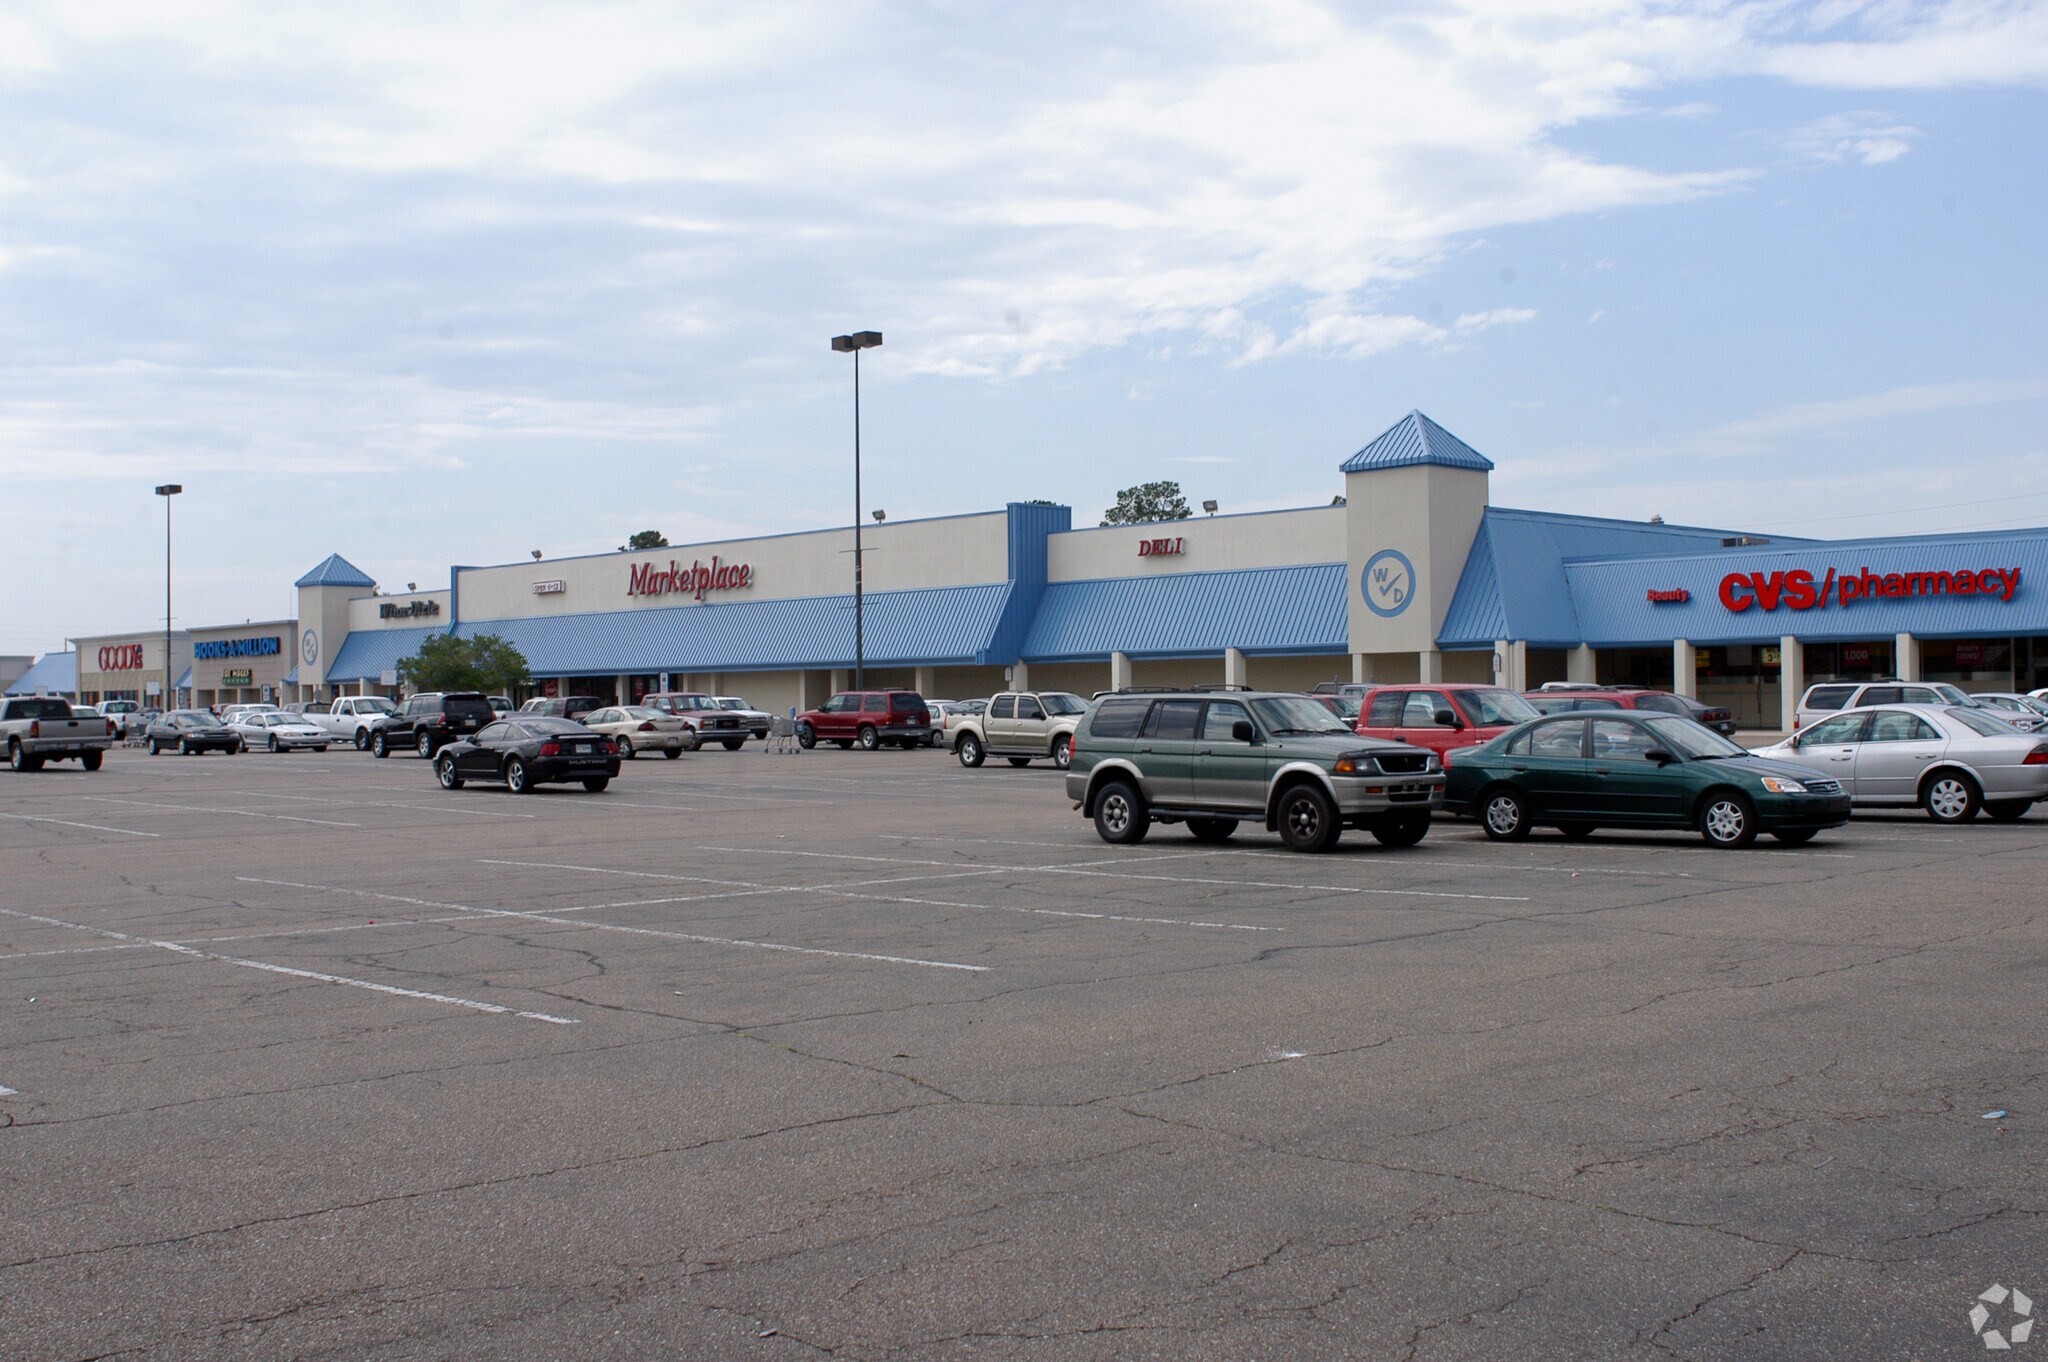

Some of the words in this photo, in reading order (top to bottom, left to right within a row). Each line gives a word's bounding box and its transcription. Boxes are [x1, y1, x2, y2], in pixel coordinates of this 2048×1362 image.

[1138, 537, 1182, 556] DELI
[627, 556, 751, 600] Marketplace
[1373, 568, 1388, 582] W
[1394, 588, 1404, 604] D
[1648, 588, 1688, 603] Beauty
[1718, 567, 2021, 611] CVS/pharmacy
[194, 636, 281, 660] BOOKS-A-MILLION
